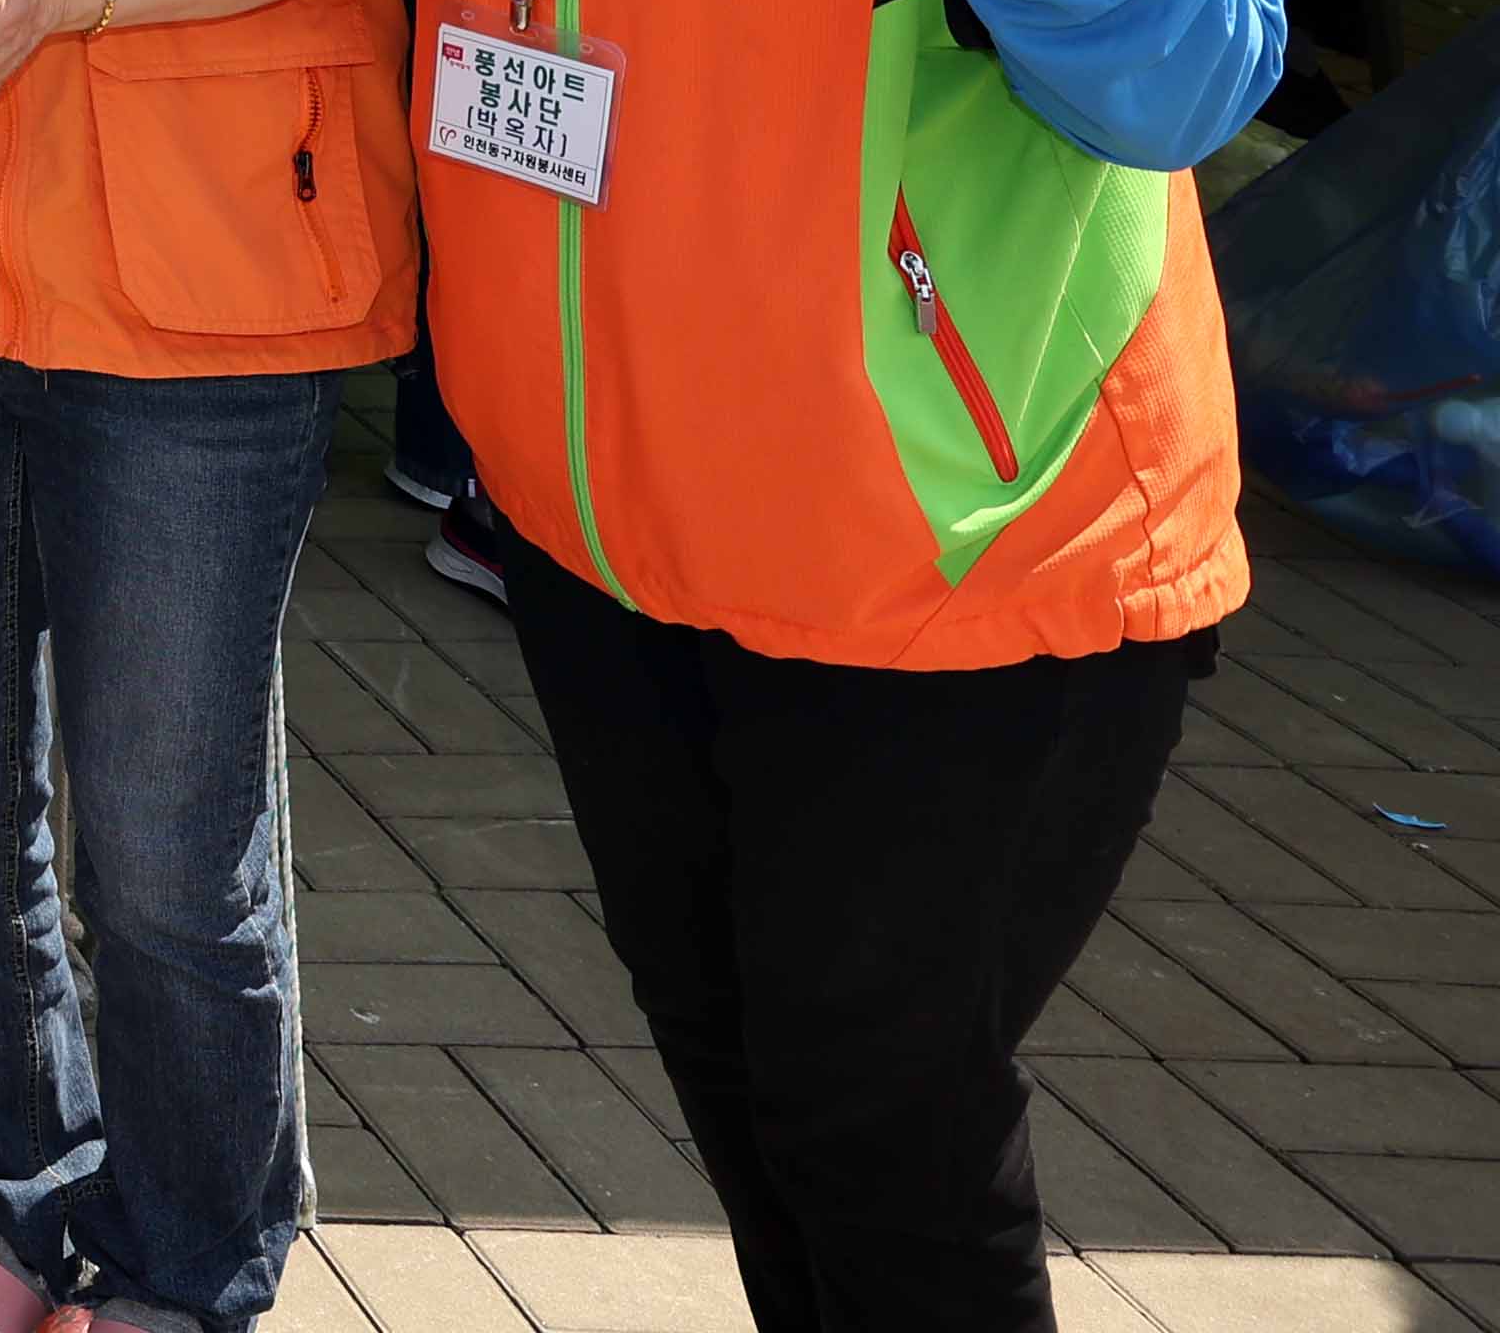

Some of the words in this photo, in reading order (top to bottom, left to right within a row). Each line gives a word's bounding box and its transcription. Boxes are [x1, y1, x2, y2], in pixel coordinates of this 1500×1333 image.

[474, 47, 586, 103] 풍선아트
[479, 79, 563, 127] 봉사단
[462, 133, 588, 187] 인천동구자원봉사센터
